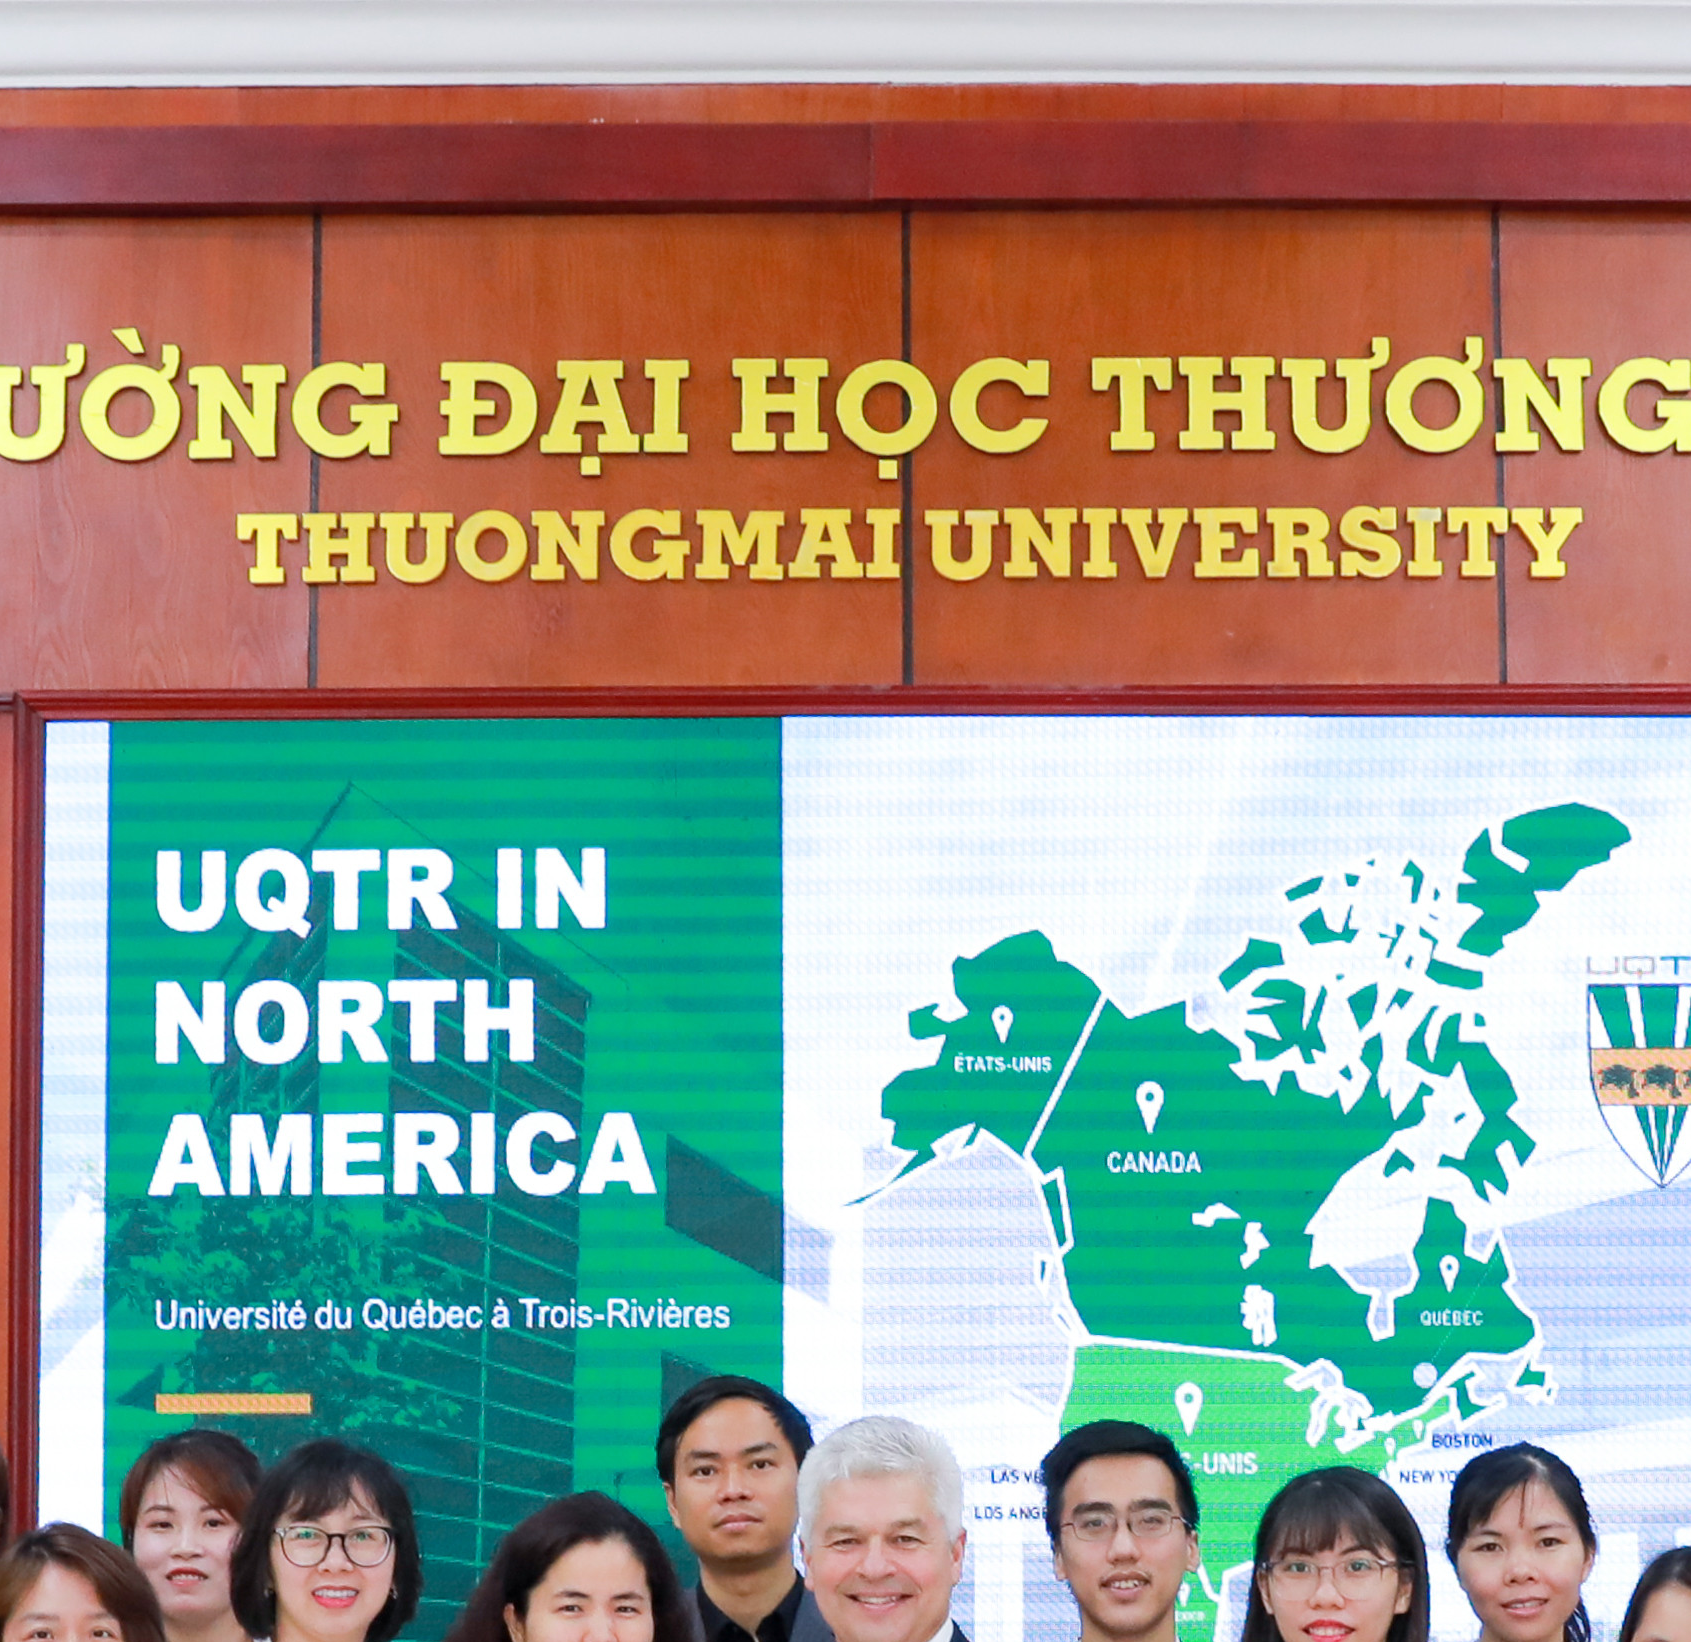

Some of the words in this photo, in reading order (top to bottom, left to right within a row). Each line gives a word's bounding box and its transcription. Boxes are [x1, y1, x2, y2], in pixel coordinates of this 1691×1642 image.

[438, 359, 691, 476] ĐẠI
[731, 357, 1050, 480] HỌC
[236, 507, 902, 585] THUONGMAI
[924, 504, 1584, 581] UNIVERSITY
[155, 848, 457, 941] UQTR
[497, 847, 607, 930] IN
[155, 979, 536, 1064] NORTH
[953, 1052, 1053, 1073] ÉTATS-UNIS
[148, 1112, 657, 1197] AMERICA
[1107, 1151, 1203, 1174] CANADA
[155, 1299, 308, 1331] Université
[314, 1299, 353, 1330] du
[362, 1298, 483, 1331] Québec
[490, 1298, 511, 1329] à
[518, 1298, 731, 1329] Trois-Rivières
[1420, 1308, 1484, 1327] QUÉBEC
[1432, 1432, 1493, 1449] BOSTON
[991, 1469, 1020, 1484] LAS
[1399, 1470, 1434, 1484] NEW
[974, 1506, 1003, 1520] LOS
